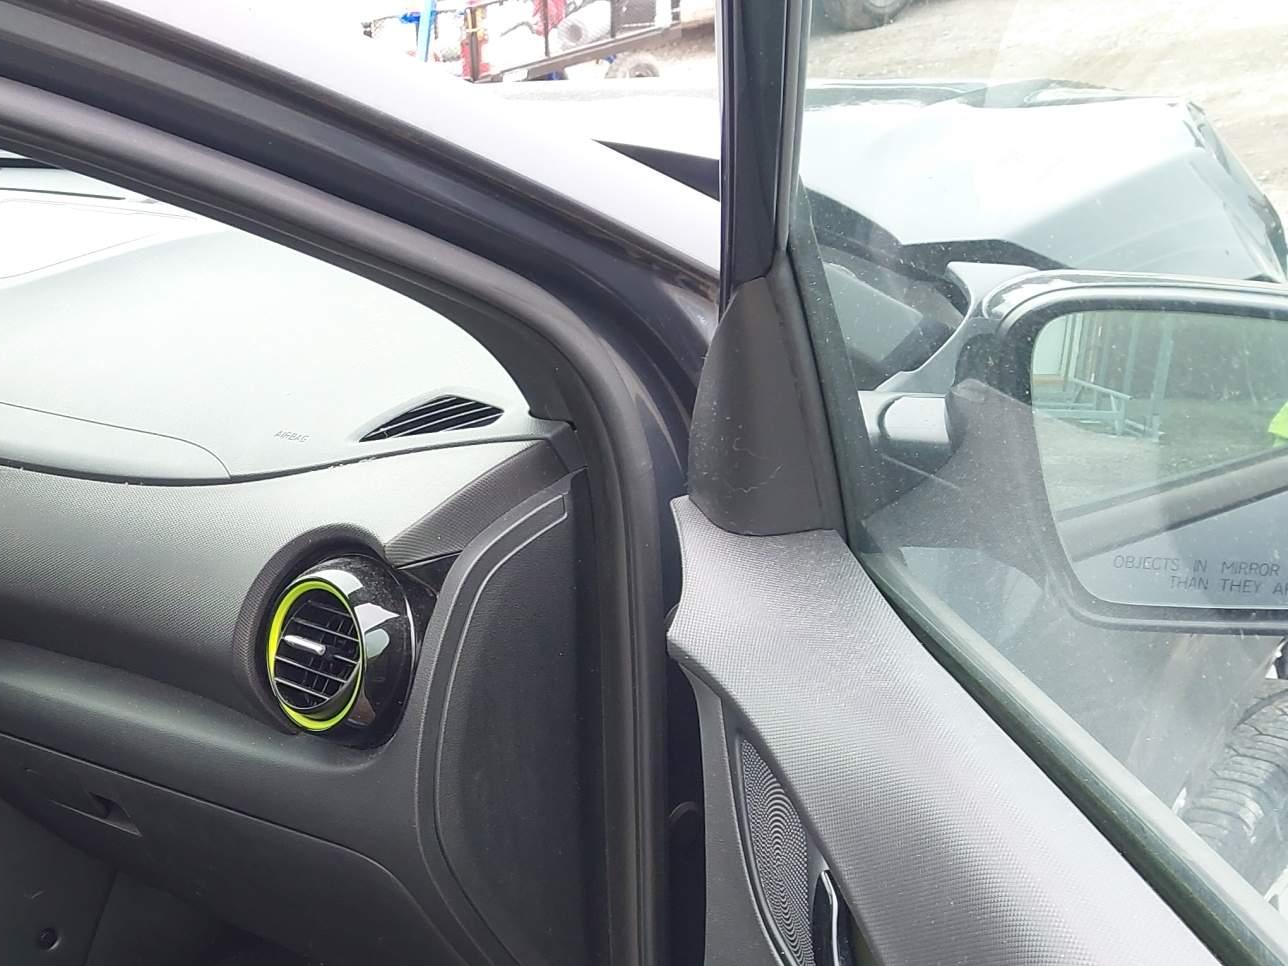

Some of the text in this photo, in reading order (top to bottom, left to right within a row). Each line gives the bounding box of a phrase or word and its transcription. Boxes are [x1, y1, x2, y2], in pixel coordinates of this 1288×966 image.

[274, 430, 312, 443] AIRBAG
[1112, 554, 1281, 577] OBJECTS IN MIRROR
[1169, 575, 1209, 590] THAN
[1220, 578, 1263, 594] THEY
